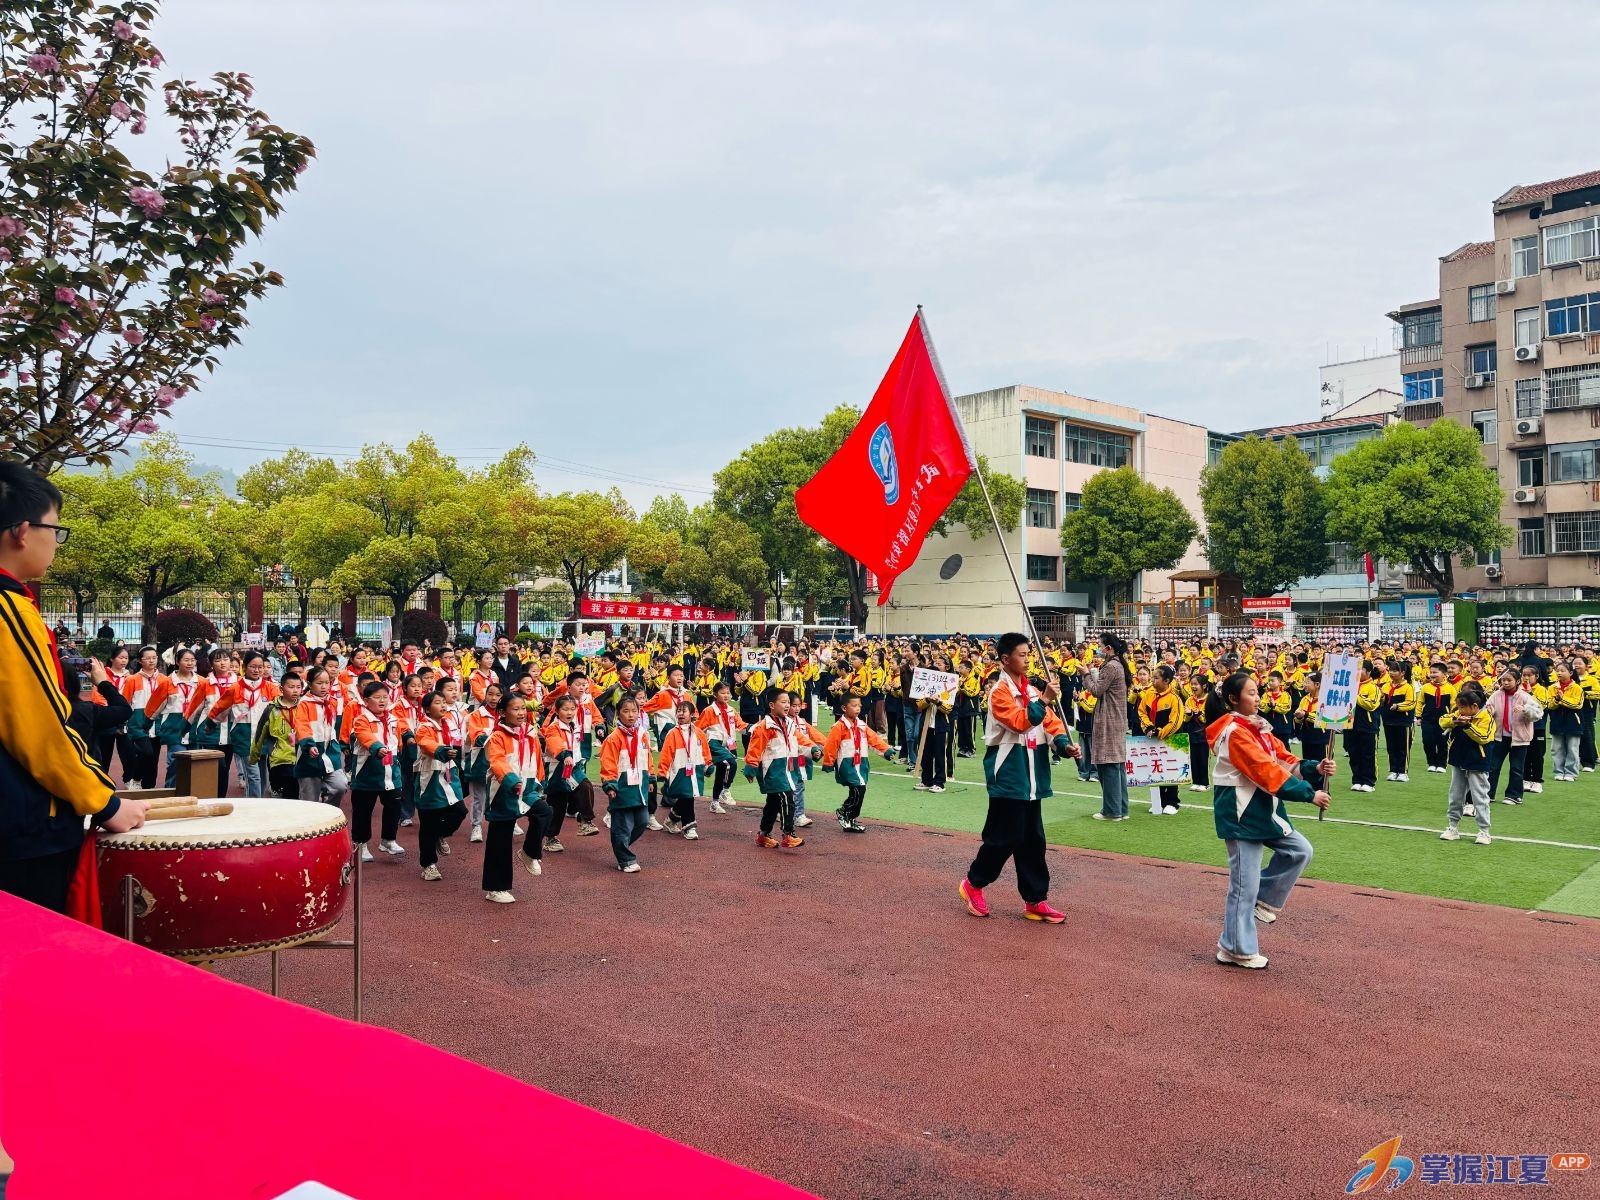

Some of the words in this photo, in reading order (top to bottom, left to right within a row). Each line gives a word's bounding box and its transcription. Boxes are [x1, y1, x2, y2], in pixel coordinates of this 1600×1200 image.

[591, 603, 629, 615] 我运动
[637, 605, 673, 618] 我健康
[681, 608, 716, 620] 我快乐
[1332, 669, 1352, 687] 江夏区
[915, 684, 937, 697] 加油
[1326, 688, 1351, 707] 舒安小学
